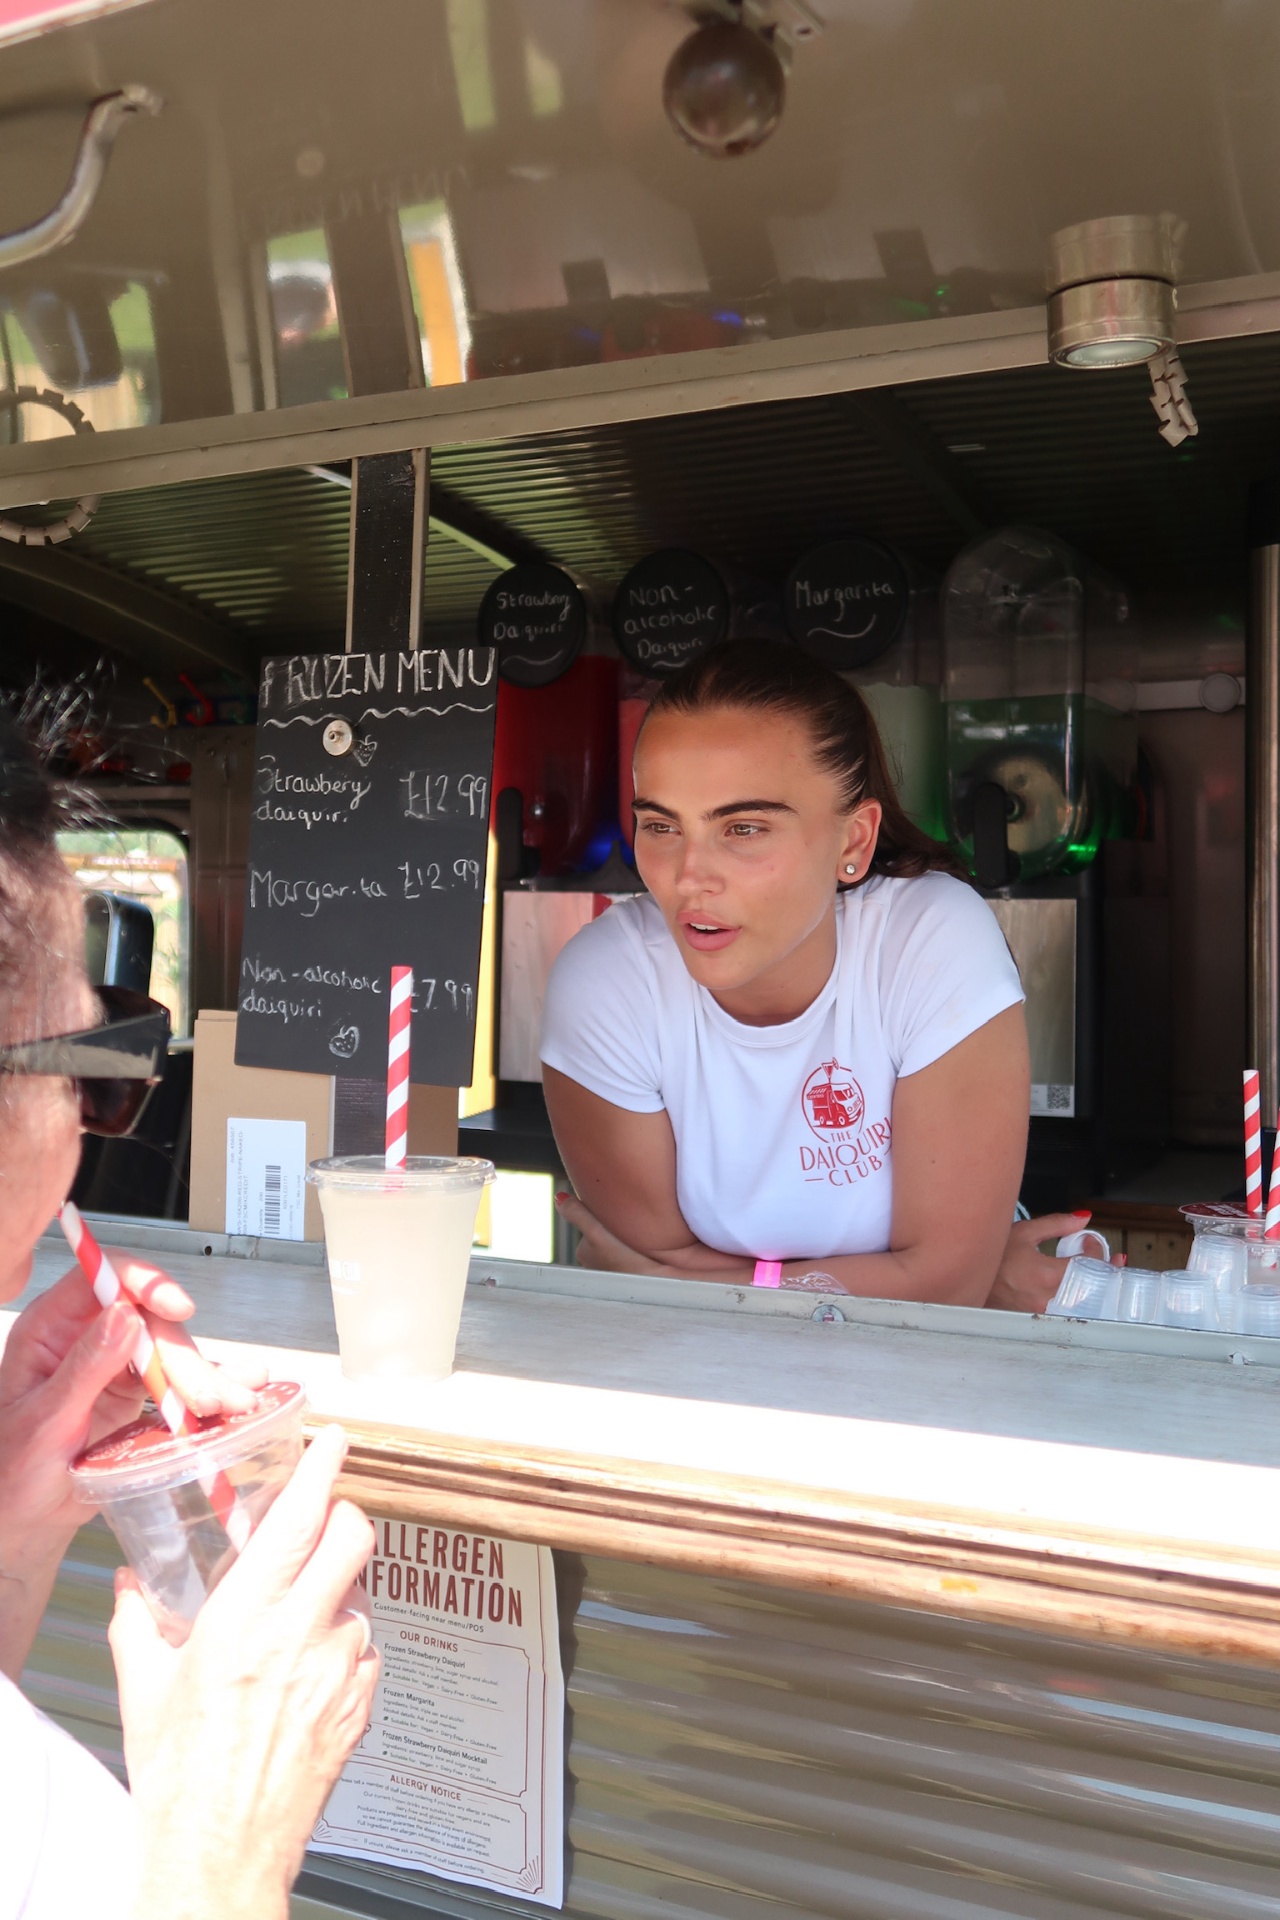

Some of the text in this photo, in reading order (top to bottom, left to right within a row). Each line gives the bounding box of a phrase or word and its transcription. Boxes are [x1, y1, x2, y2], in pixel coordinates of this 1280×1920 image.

[796, 580, 895, 622] Margarita
[624, 605, 717, 635] alcoholic
[398, 647, 496, 695] MENU
[399, 770, 488, 823] £12.99
[250, 859, 481, 918] Margarita £12.99
[242, 955, 383, 994] Non-alcoholic
[241, 988, 322, 1024] daiquiri
[831, 1130, 853, 1143] THE
[829, 1155, 882, 1187] CLUB
[354, 1560, 523, 1628] NFORMATION
[374, 1602, 485, 1634] Customer-facing near menu/POS
[384, 1642, 465, 1669] Frozen Strawberry Daiquiri
[400, 1630, 458, 1654] OUR DRINKS
[383, 1686, 434, 1707] Frozen Margarita
[392, 1672, 410, 1682] Suitable
[421, 1680, 434, 1689] Vegan
[441, 1686, 453, 1695] Dairy
[470, 1693, 497, 1705] Gluten-Free
[382, 1729, 487, 1765] Frozen Strawberry Daiquiri Mocktail
[390, 1717, 408, 1726] Suitable
[420, 1725, 433, 1733] Vegan
[440, 1730, 452, 1739] Dairy
[469, 1738, 496, 1750] Gluten-Free
[389, 1752, 408, 1761] Suitable
[419, 1760, 433, 1768] Vegan
[440, 1765, 451, 1773] Dairy
[469, 1773, 496, 1785] Gluten-Free
[366, 1781, 383, 1790] member
[400, 1789, 414, 1798] before
[389, 1773, 461, 1801] ALLERGY NOTICE
[357, 1804, 377, 1814] Products
[386, 1810, 406, 1820] prepared
[363, 1790, 372, 1798] Our
[429, 1806, 446, 1815] suitable
[455, 1814, 472, 1823] vegans
[366, 1821, 388, 1830] ingredient
[392, 1819, 415, 1829] guarantee
[385, 1843, 400, 1852] please
